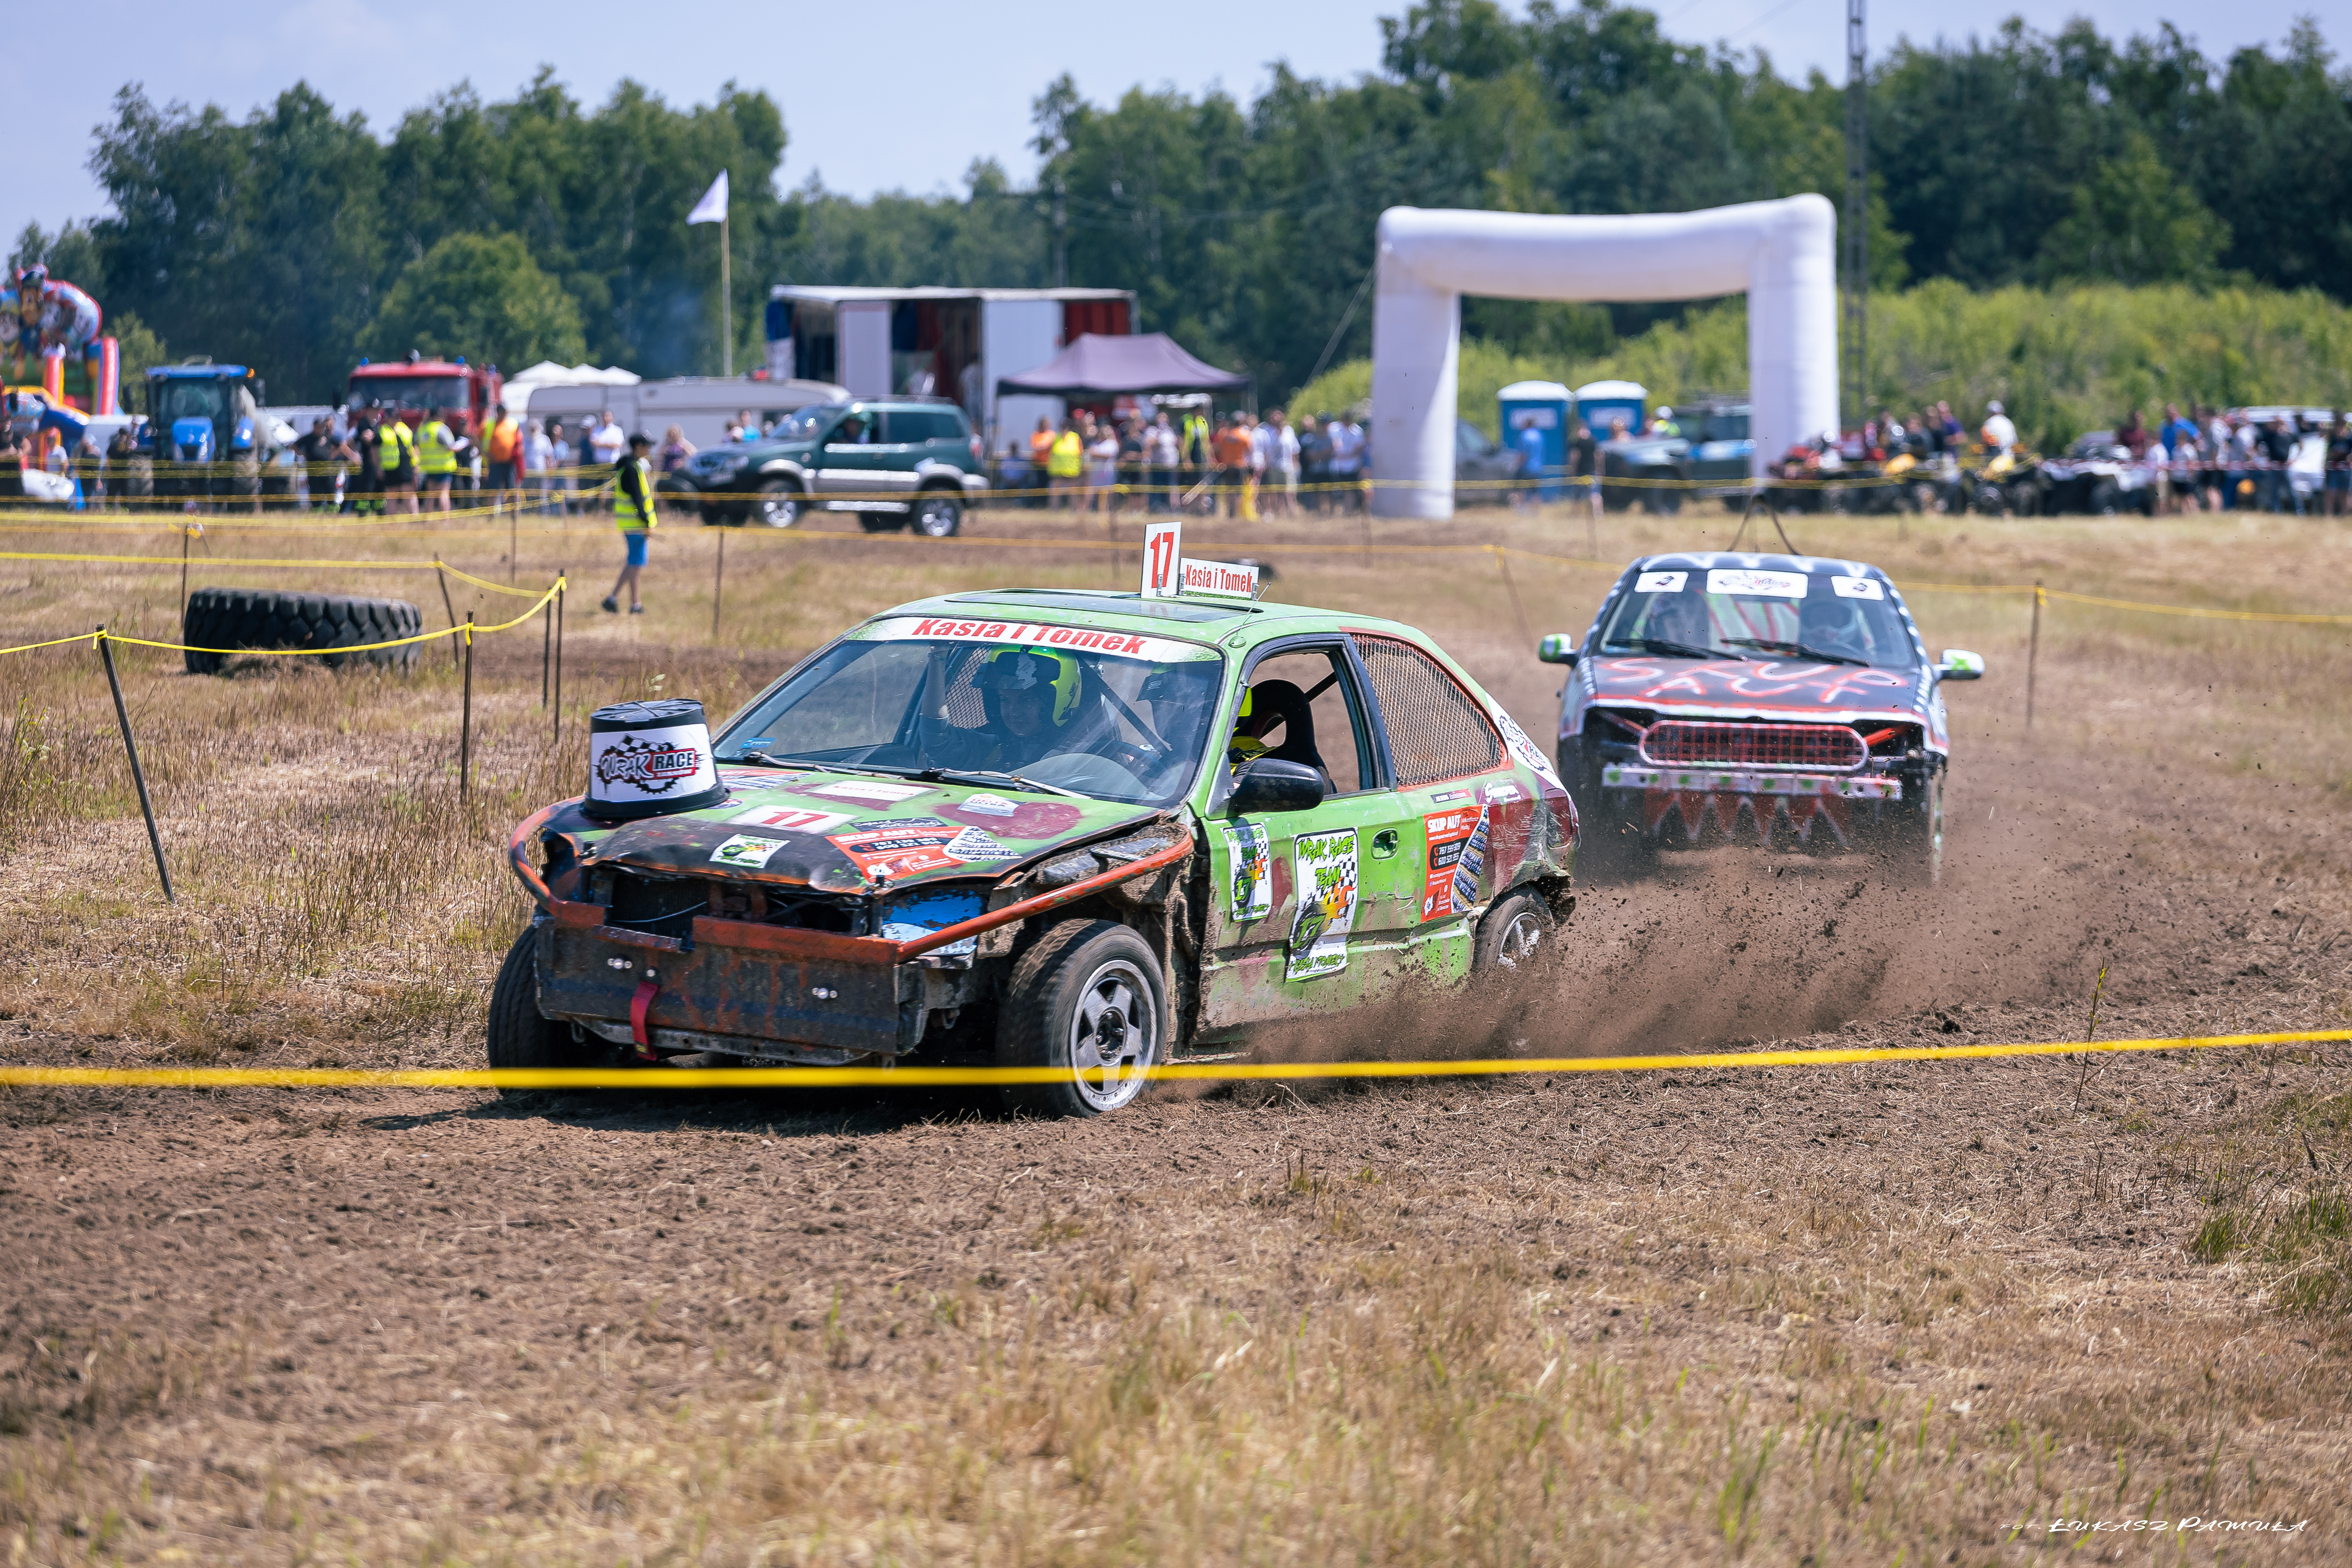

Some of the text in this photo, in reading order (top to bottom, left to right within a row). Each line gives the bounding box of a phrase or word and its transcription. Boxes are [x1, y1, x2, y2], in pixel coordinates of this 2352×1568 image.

[1150, 532, 1174, 588] 17
[1186, 565, 1252, 592] Kasia i Tomek
[912, 619, 1007, 638] Kasia
[1033, 625, 1147, 654] Tomek
[601, 752, 694, 780] WRAK RACE
[761, 811, 830, 827] 17
[1428, 814, 1462, 833] SKUP AUT
[834, 832, 881, 842] SKUP
[882, 829, 916, 837] AUT
[1295, 834, 1354, 863] WRAK RACE
[1235, 878, 1251, 901] 17
[1315, 866, 1341, 890] TEAM
[1292, 913, 1326, 949] 17
